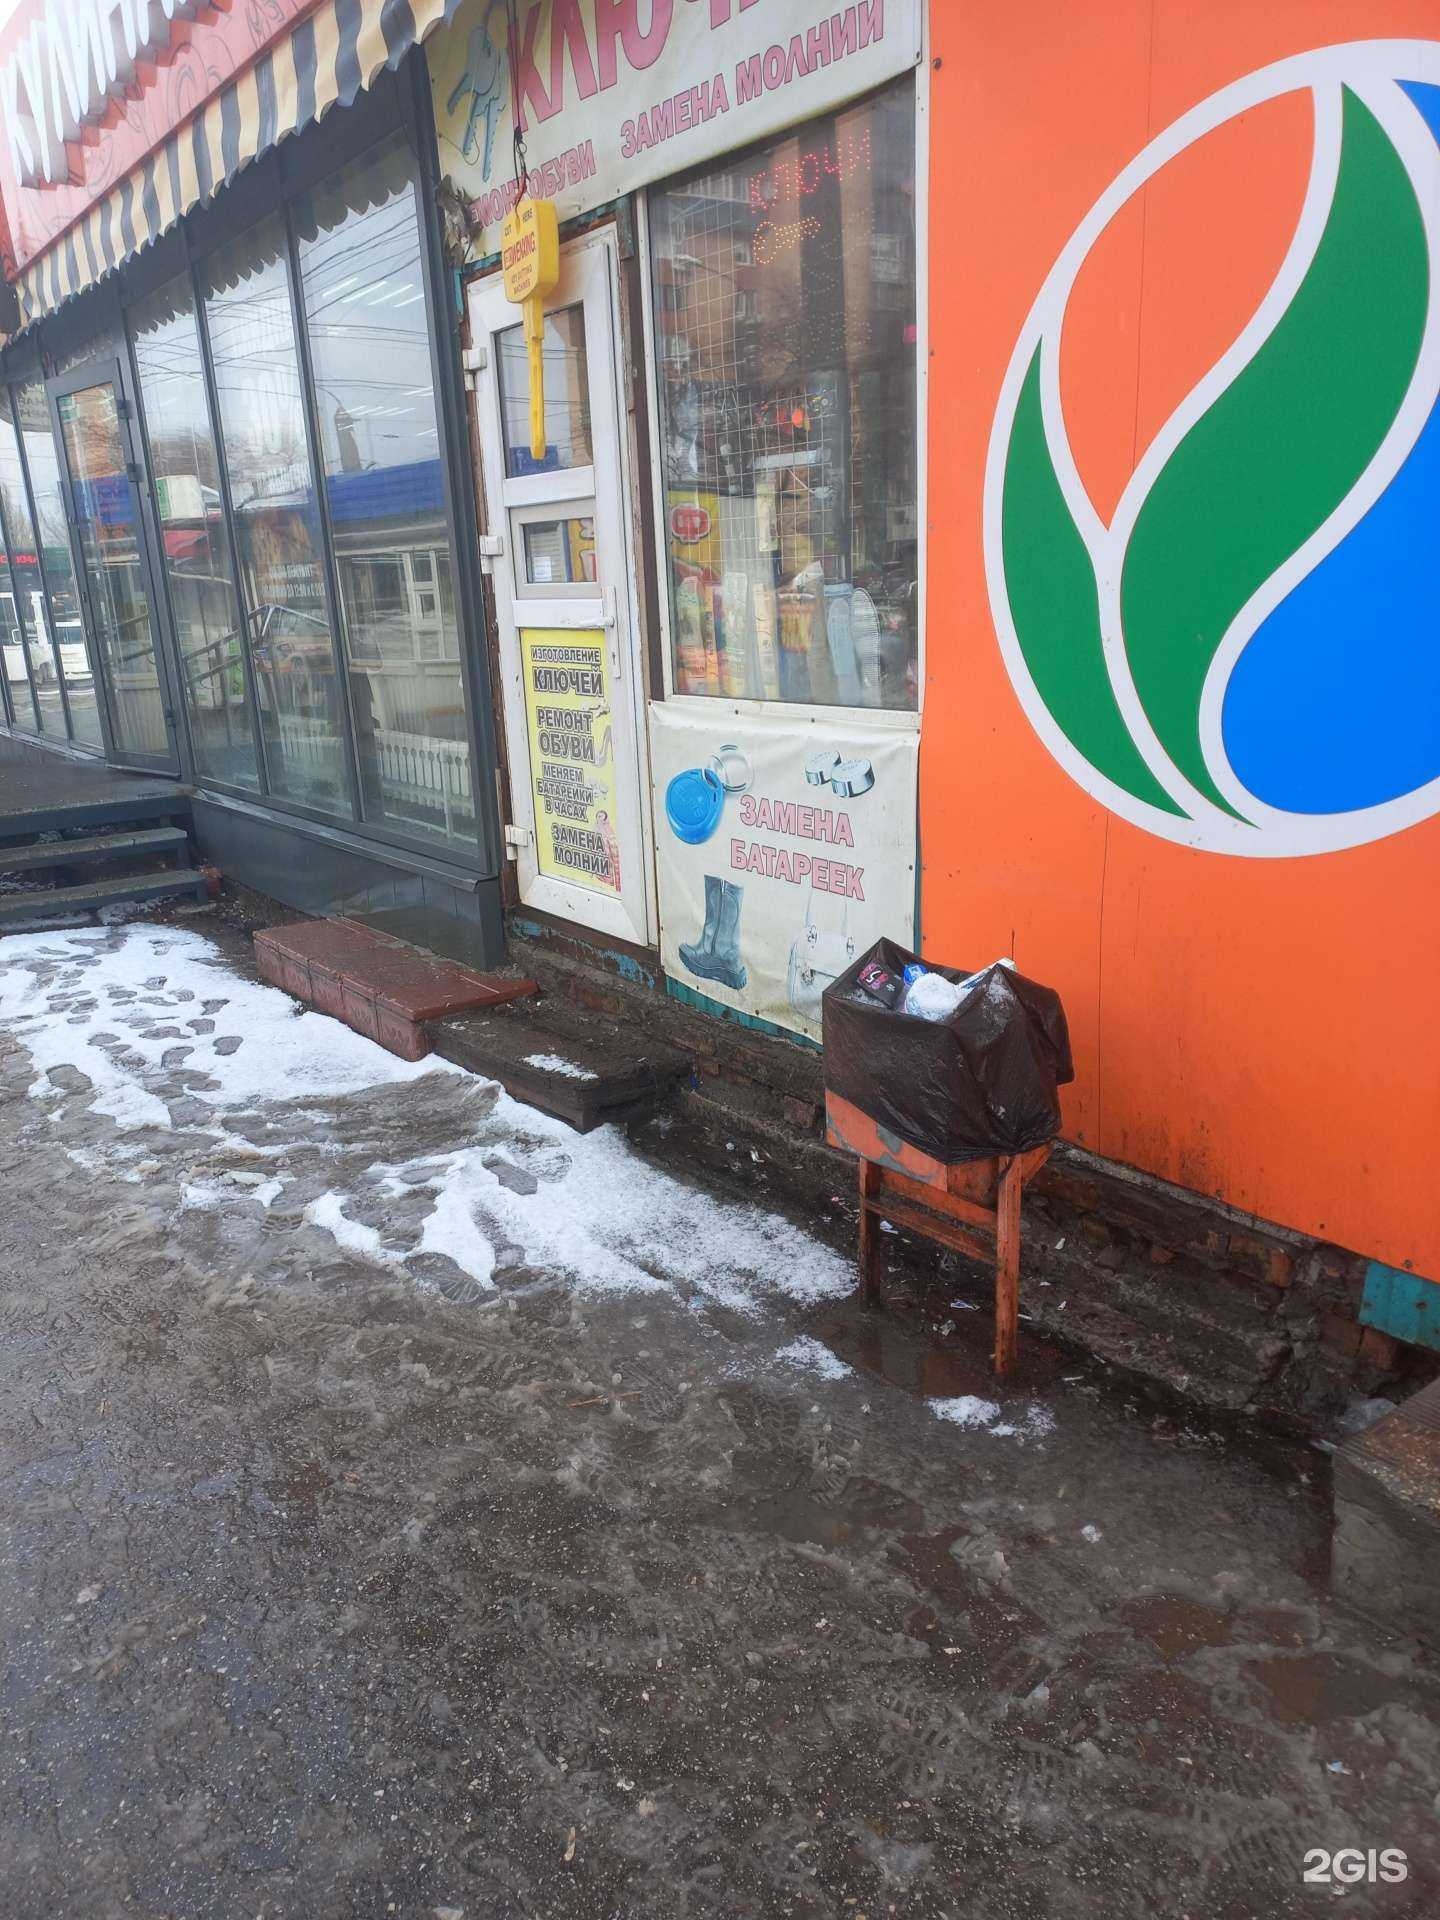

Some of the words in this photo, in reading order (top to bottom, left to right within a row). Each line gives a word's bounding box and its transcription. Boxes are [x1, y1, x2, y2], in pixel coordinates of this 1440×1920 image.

[506, 0, 760, 133] КЛЮ
[528, 139, 597, 201] ОБУВИ
[620, 73, 729, 158] ЗАМЕНА
[750, 128, 872, 215] КЛЮЧИ
[531, 646, 601, 663] ИЗГОТОВЛЕНИЕ
[533, 665, 603, 695] КЛЮЧЕЙ
[537, 707, 592, 733] РЕМОНТ
[539, 731, 594, 761] ОБУВИ
[543, 764, 582, 783] МЕНЯЕМ
[545, 799, 552, 813] В
[554, 800, 586, 819] ЧАСАХ
[740, 795, 855, 847] ЗАМЕНА
[552, 824, 605, 853] ЗАМЕНА
[731, 839, 865, 901] БАТАРЕЕК
